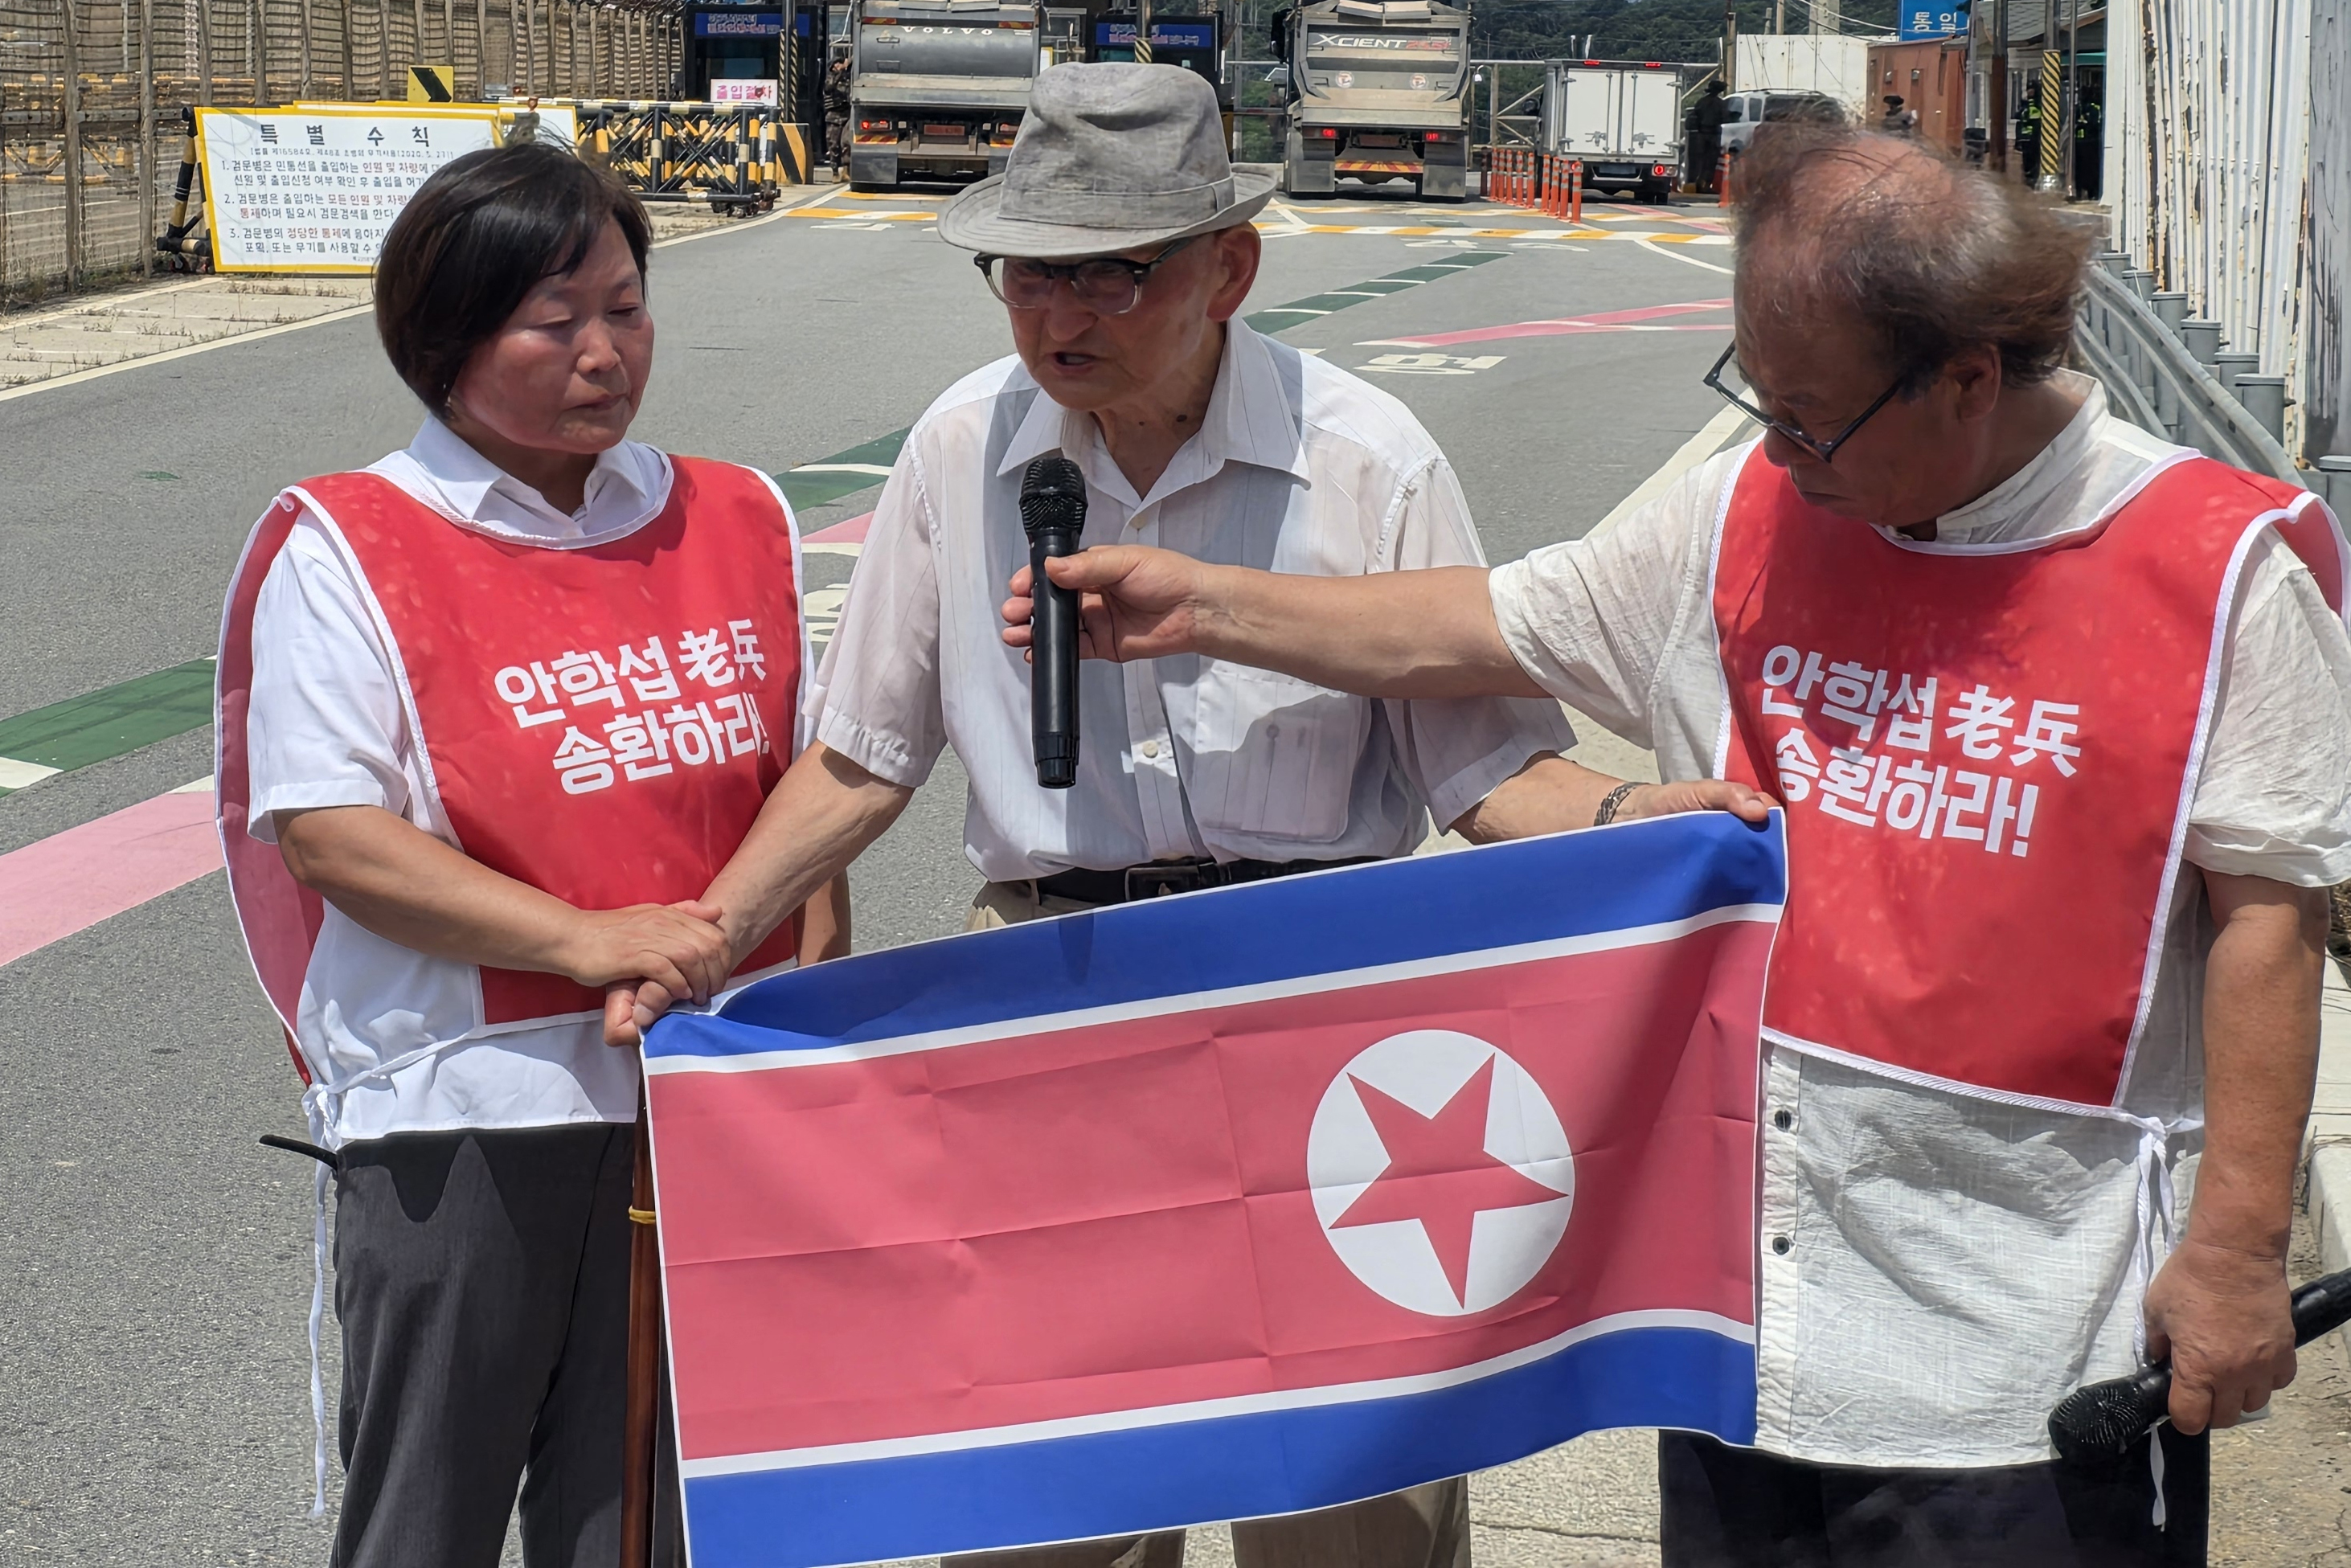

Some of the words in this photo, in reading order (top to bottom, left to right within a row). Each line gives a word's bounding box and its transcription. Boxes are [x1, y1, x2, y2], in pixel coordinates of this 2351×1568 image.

[902, 26, 993, 35] VOLVO
[1313, 34, 1407, 48] XCIENT
[260, 124, 326, 145] 특별
[367, 125, 429, 147] 수칙
[222, 160, 229, 170] 1.
[232, 160, 272, 172] 검문병은
[321, 161, 358, 173] 출입하는
[363, 162, 383, 174] 인원
[387, 162, 395, 174] 및
[234, 174, 253, 186] 신원
[257, 174, 266, 186] 및
[314, 175, 333, 186] 여부
[337, 175, 355, 187] 확인
[360, 176, 369, 187] 후
[373, 176, 402, 188] 출입을
[224, 194, 235, 204] 2.
[237, 193, 278, 205] 검문병은
[284, 193, 324, 205] 출입하는
[328, 194, 346, 206] 모든
[350, 194, 370, 206] 인원
[374, 194, 383, 206] 및
[285, 207, 317, 219] 필요시
[320, 207, 368, 220] 검문검색을
[229, 227, 240, 239] 3.
[243, 227, 283, 239] 검문병의
[287, 227, 318, 239] 정당한
[272, 242, 292, 254] 또는
[296, 242, 326, 254] 무기를
[330, 242, 359, 254] 사용할
[362, 243, 371, 254] 수
[494, 635, 682, 729] 안학섭
[678, 618, 767, 688] 老兵
[1761, 645, 1938, 752] 안학섭
[1944, 683, 2082, 778] 老兵
[552, 691, 769, 795] 송환하라!
[1776, 727, 2040, 858] 송환하라!
